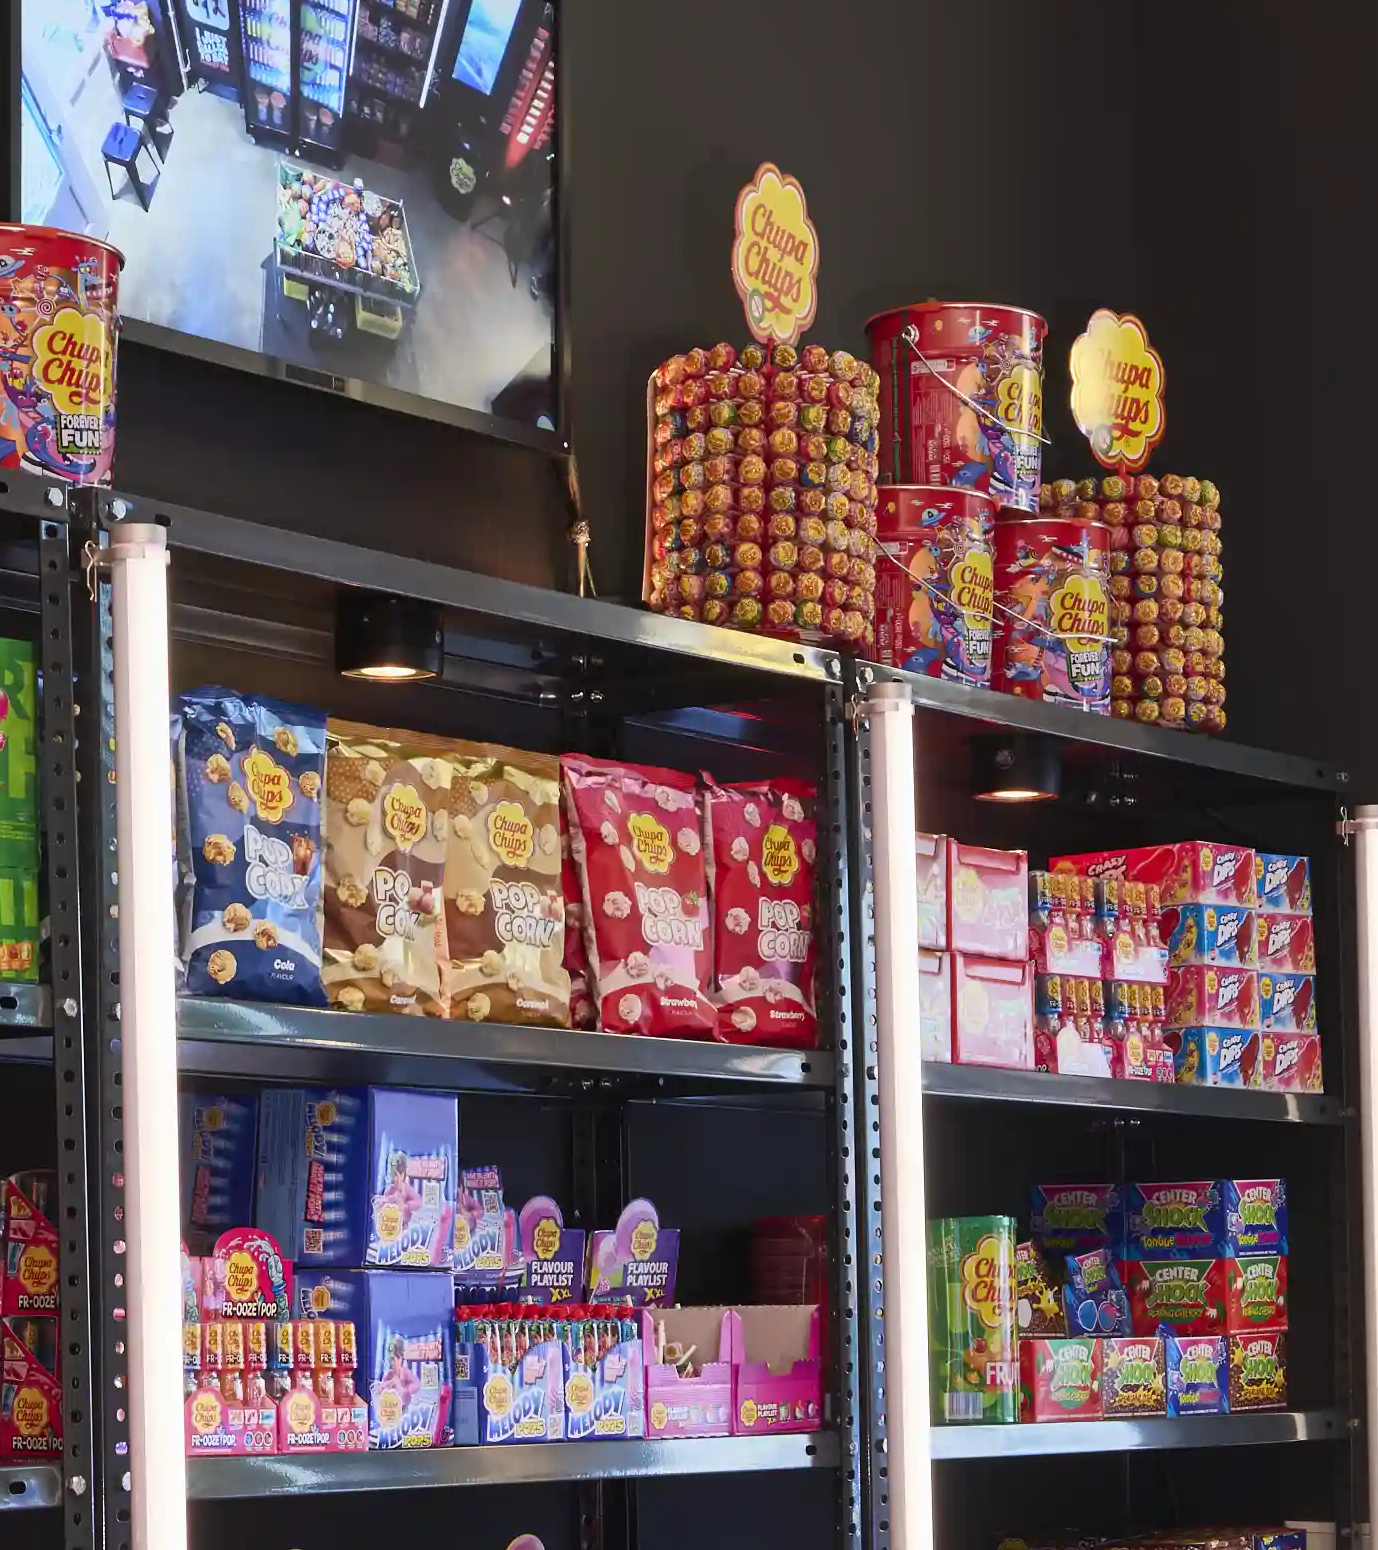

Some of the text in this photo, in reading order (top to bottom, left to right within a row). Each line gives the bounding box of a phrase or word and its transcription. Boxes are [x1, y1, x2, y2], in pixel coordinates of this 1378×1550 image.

[751, 203, 809, 265] Chupa
[745, 244, 803, 315] Chups
[62, 429, 101, 448] FUN
[1071, 663, 1100, 677] FUN
[491, 881, 541, 912] POP
[635, 882, 681, 917] POP
[758, 898, 800, 930] POP
[496, 912, 554, 947] CORN
[642, 914, 703, 950] CORN
[758, 930, 810, 962] CORN
[274, 959, 295, 972] Cola
[1153, 1189, 1197, 1204] CENTER
[531, 1262, 573, 1273] FLAVOUR
[627, 1262, 668, 1273] FLAVOUR
[1155, 1267, 1198, 1281] CENTER
[531, 1273, 574, 1287] PLAYLIST
[626, 1273, 668, 1287] PLAYLIST
[18, 1295, 57, 1309] FR-OOZE
[222, 1302, 258, 1317] FR-OOZE
[12, 1436, 49, 1450] FR-OOZE
[191, 1432, 222, 1446] FR-OOZE
